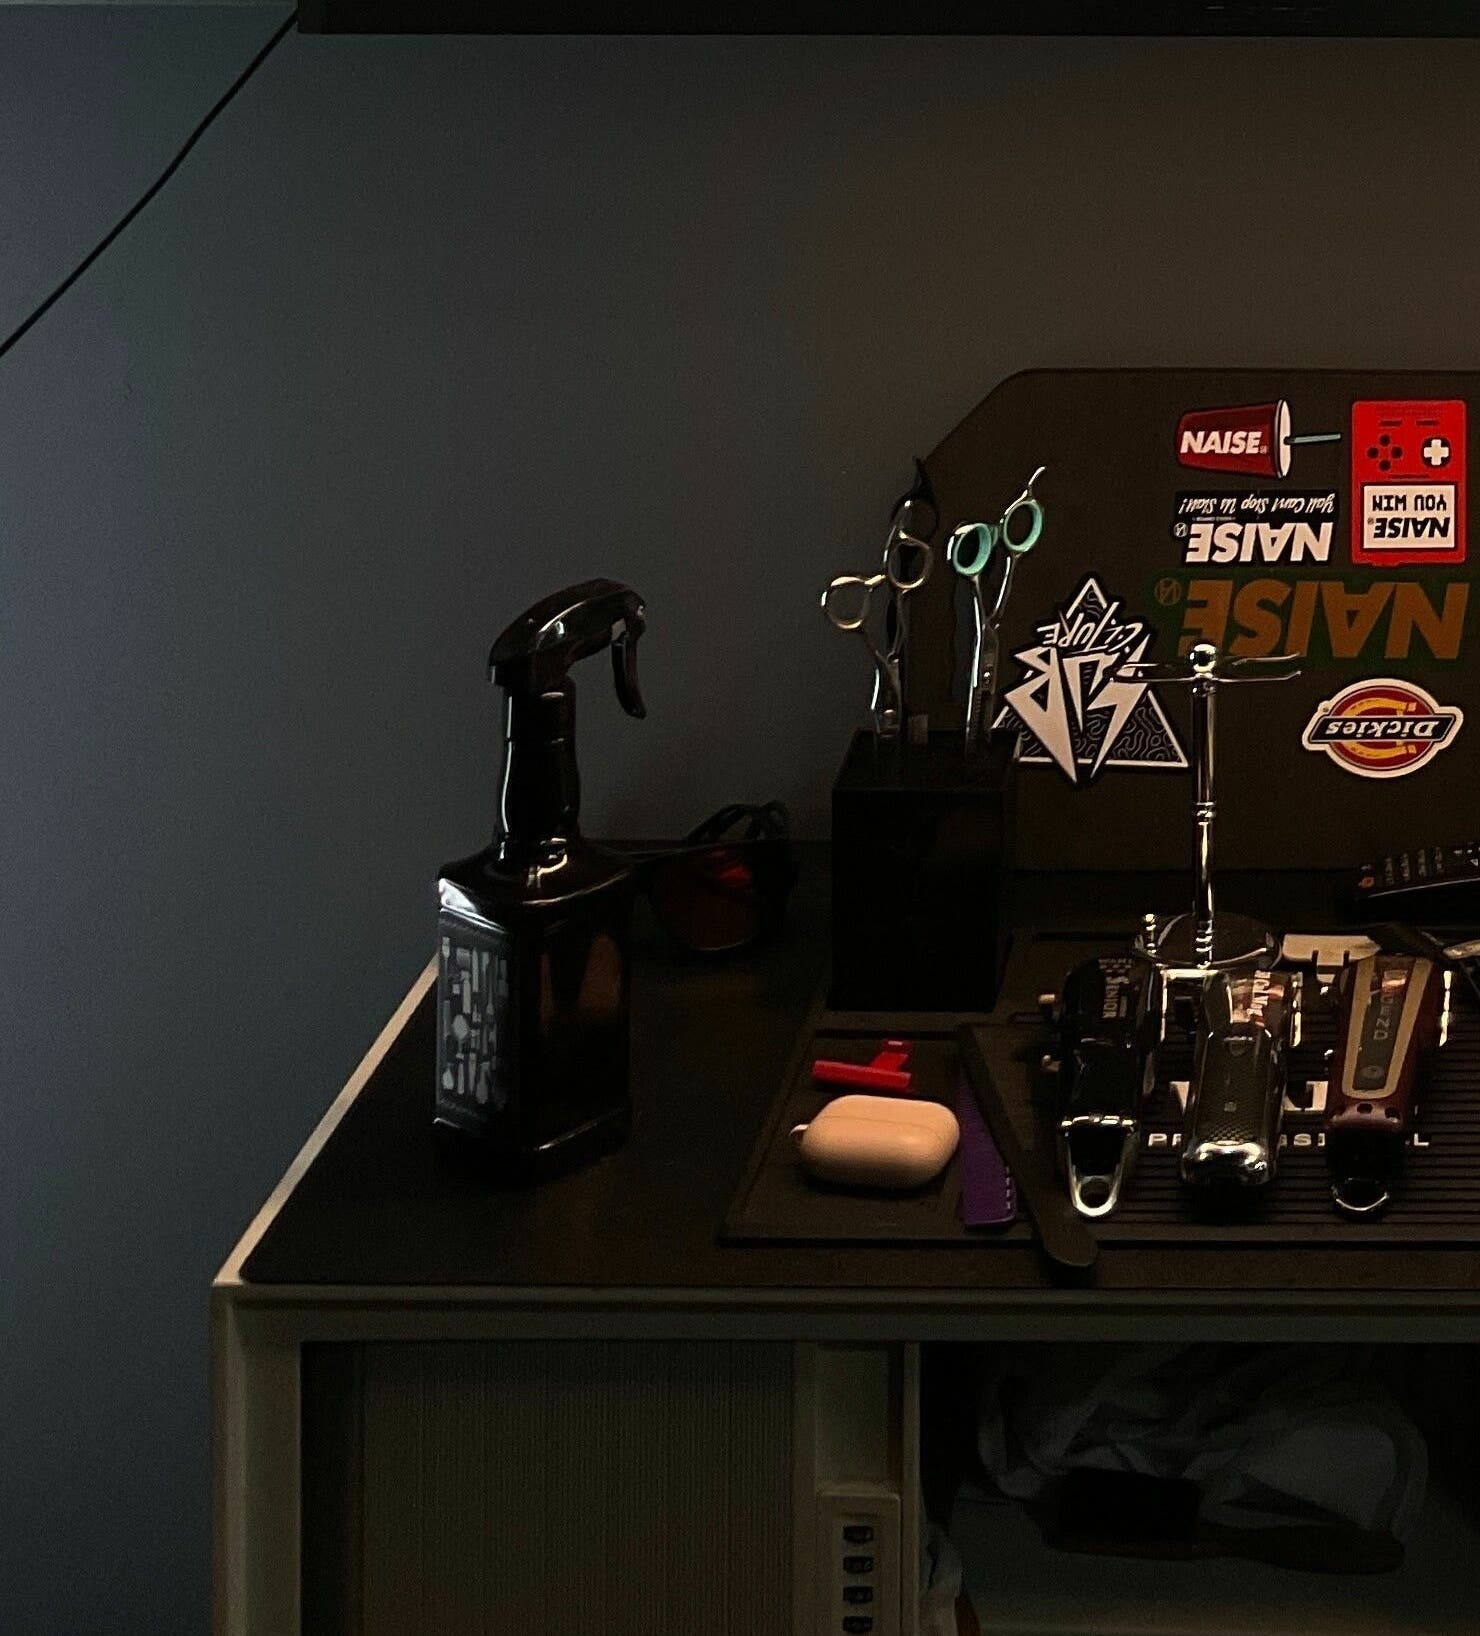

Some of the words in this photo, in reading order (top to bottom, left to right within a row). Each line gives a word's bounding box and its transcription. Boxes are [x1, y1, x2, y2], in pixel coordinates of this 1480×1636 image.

[1179, 430, 1263, 455] NAISE
[1372, 494, 1407, 511] WIN
[1414, 493, 1447, 511] YOU
[1374, 517, 1451, 538] NAISE
[1185, 522, 1334, 563] NAISE
[1178, 577, 1471, 660] NAISE
[1325, 718, 1441, 738] Dickies
